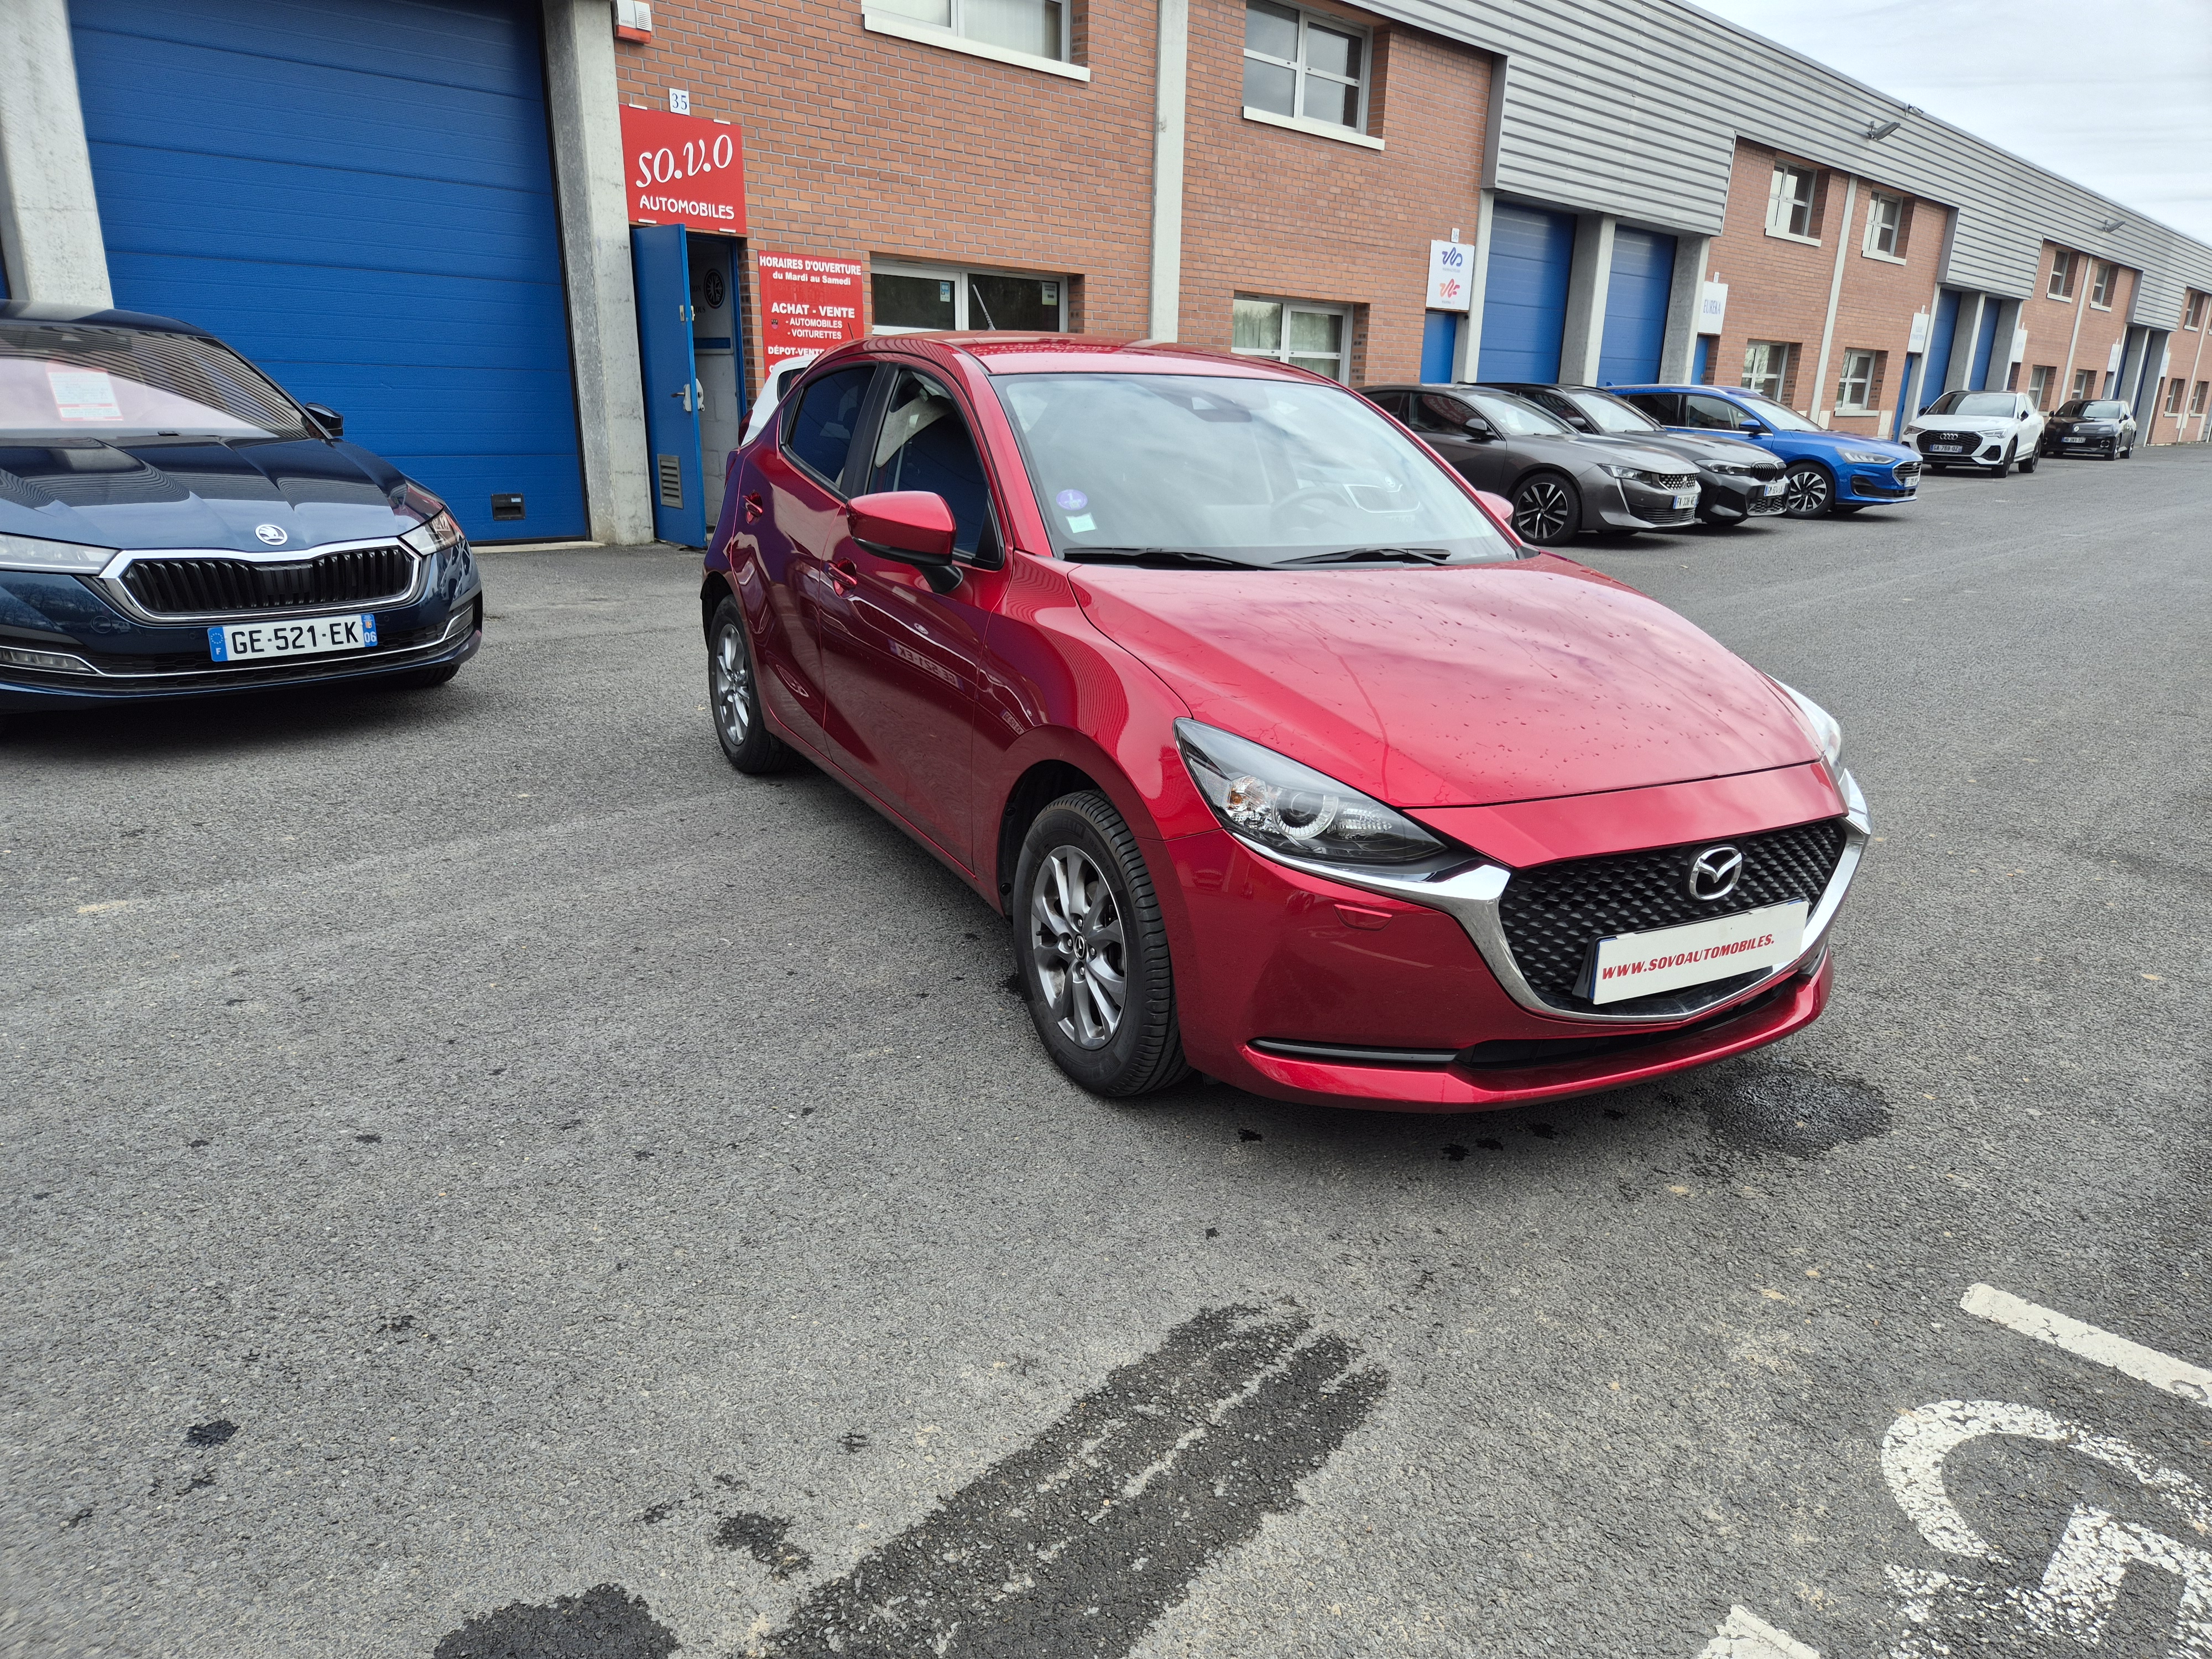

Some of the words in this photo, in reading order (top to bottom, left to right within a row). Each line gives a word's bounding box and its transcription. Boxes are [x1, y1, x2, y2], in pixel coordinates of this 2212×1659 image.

[672, 93, 687, 110] 35
[639, 195, 734, 220] AUTOMOBILES
[1452, 231, 1458, 240] 36
[759, 255, 803, 270] HORAIRES
[805, 260, 862, 275] D'OUVERTURE
[773, 271, 783, 279] du
[785, 272, 808, 282] Mardi
[822, 276, 851, 286] Samedi
[771, 302, 810, 315] ACHAT
[818, 305, 855, 319] VENTE
[1703, 299, 1721, 315] EUREKA
[231, 621, 359, 655] GE-521-EK
[364, 631, 377, 643] 06
